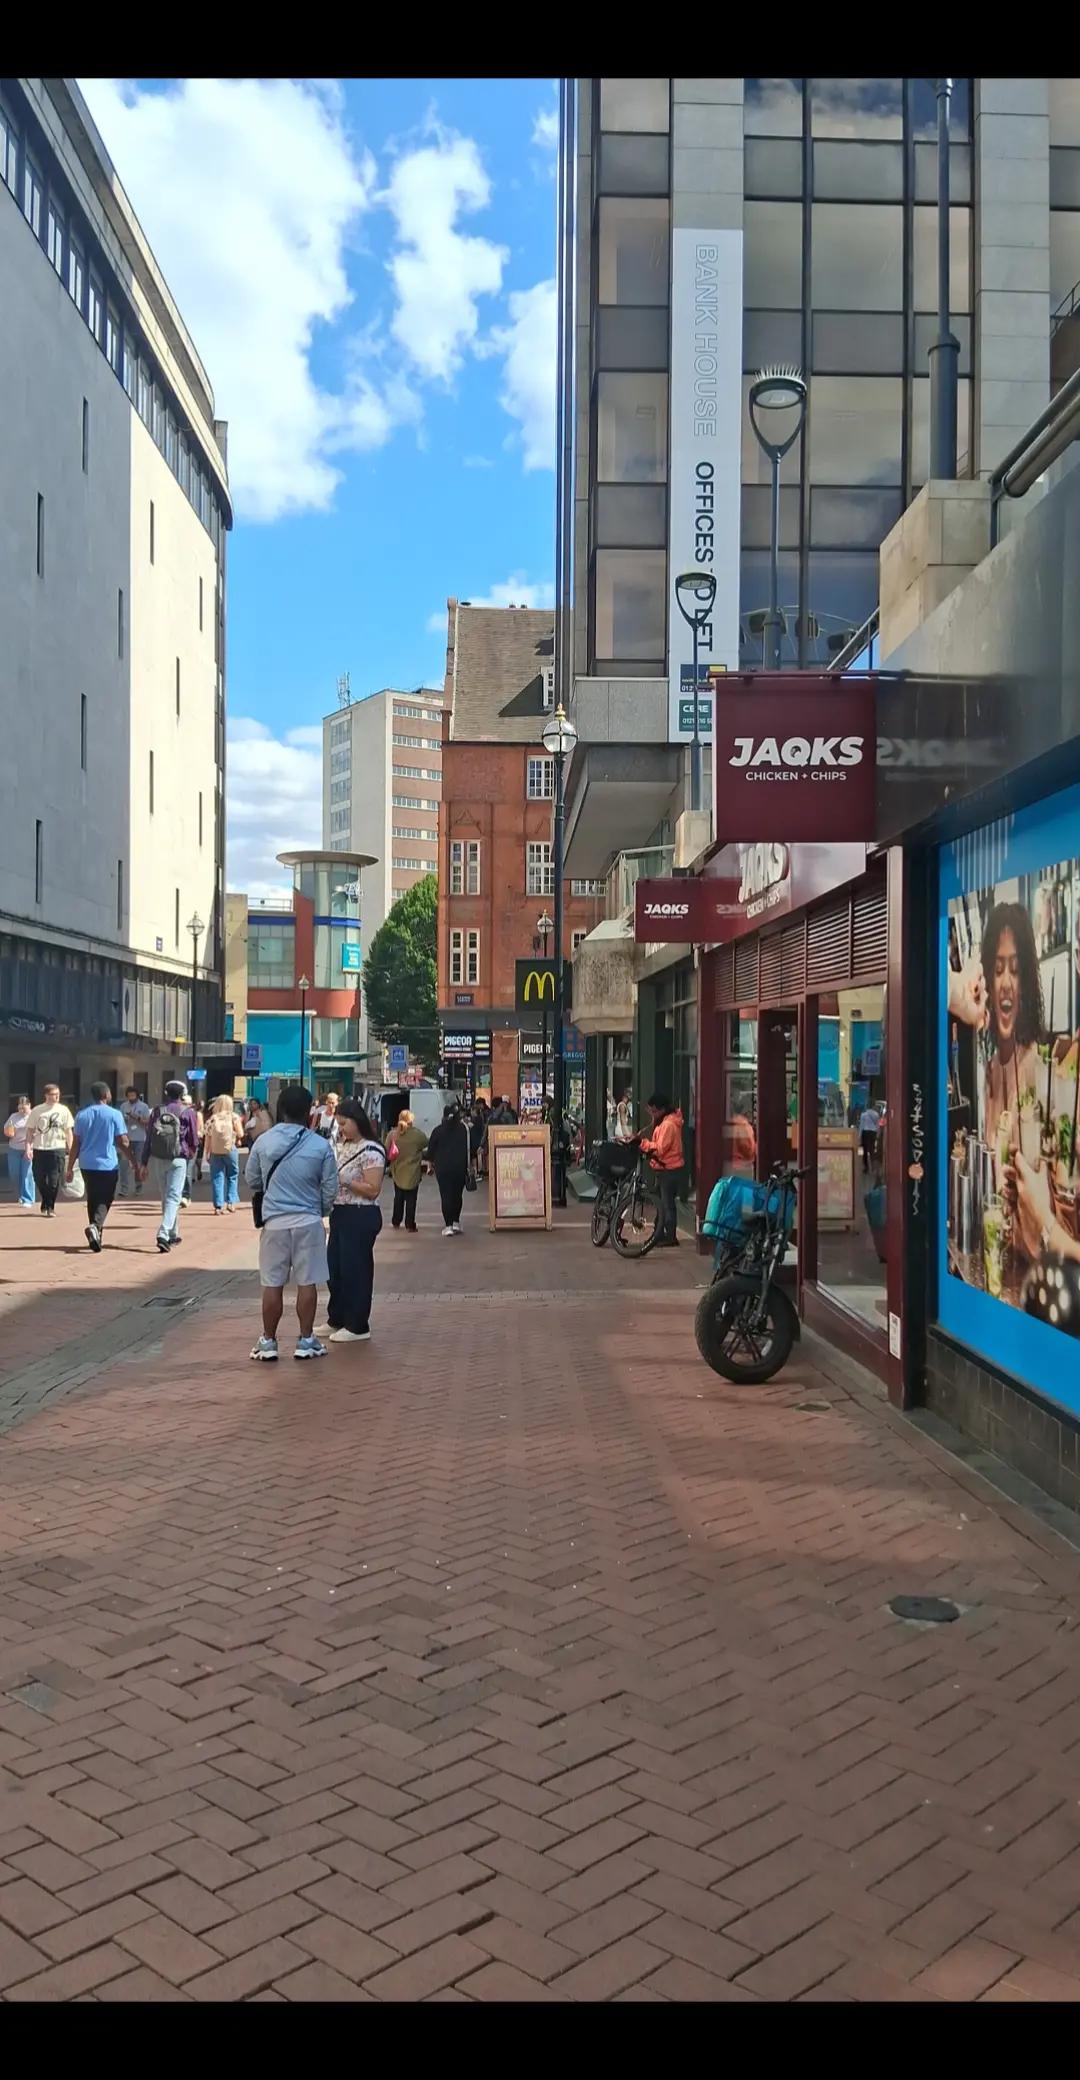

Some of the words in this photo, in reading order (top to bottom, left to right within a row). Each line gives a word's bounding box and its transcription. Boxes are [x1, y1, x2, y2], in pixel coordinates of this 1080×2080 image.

[696, 245, 718, 326] BANK
[694, 333, 718, 436] HOUSE
[695, 462, 715, 563] OFFICES
[729, 736, 864, 768] JAQKS
[745, 771, 799, 781] CHICKEN
[811, 771, 847, 781] CHIPS
[644, 903, 689, 915] JAQKS
[444, 1035, 473, 1046] PIGEON
